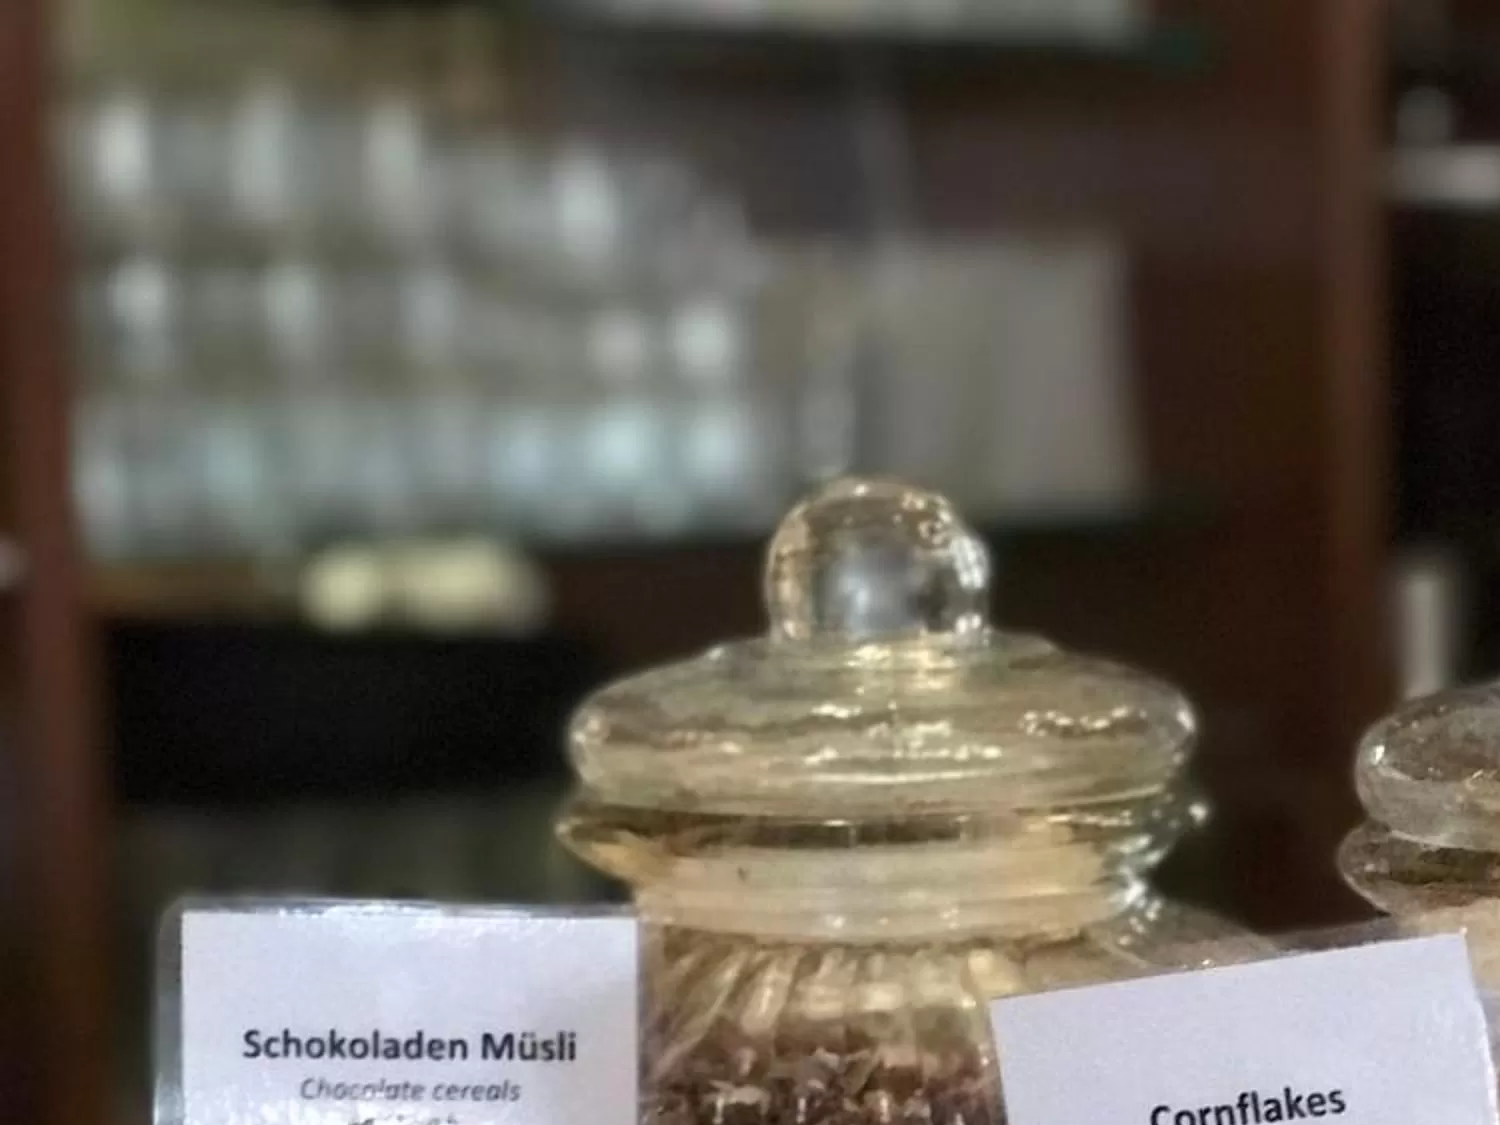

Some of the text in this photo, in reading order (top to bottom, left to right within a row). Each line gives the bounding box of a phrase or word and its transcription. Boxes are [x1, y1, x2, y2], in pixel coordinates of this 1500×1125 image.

[242, 1028, 577, 1062] Schokoladen Müsli
[432, 1079, 521, 1102] cereals
